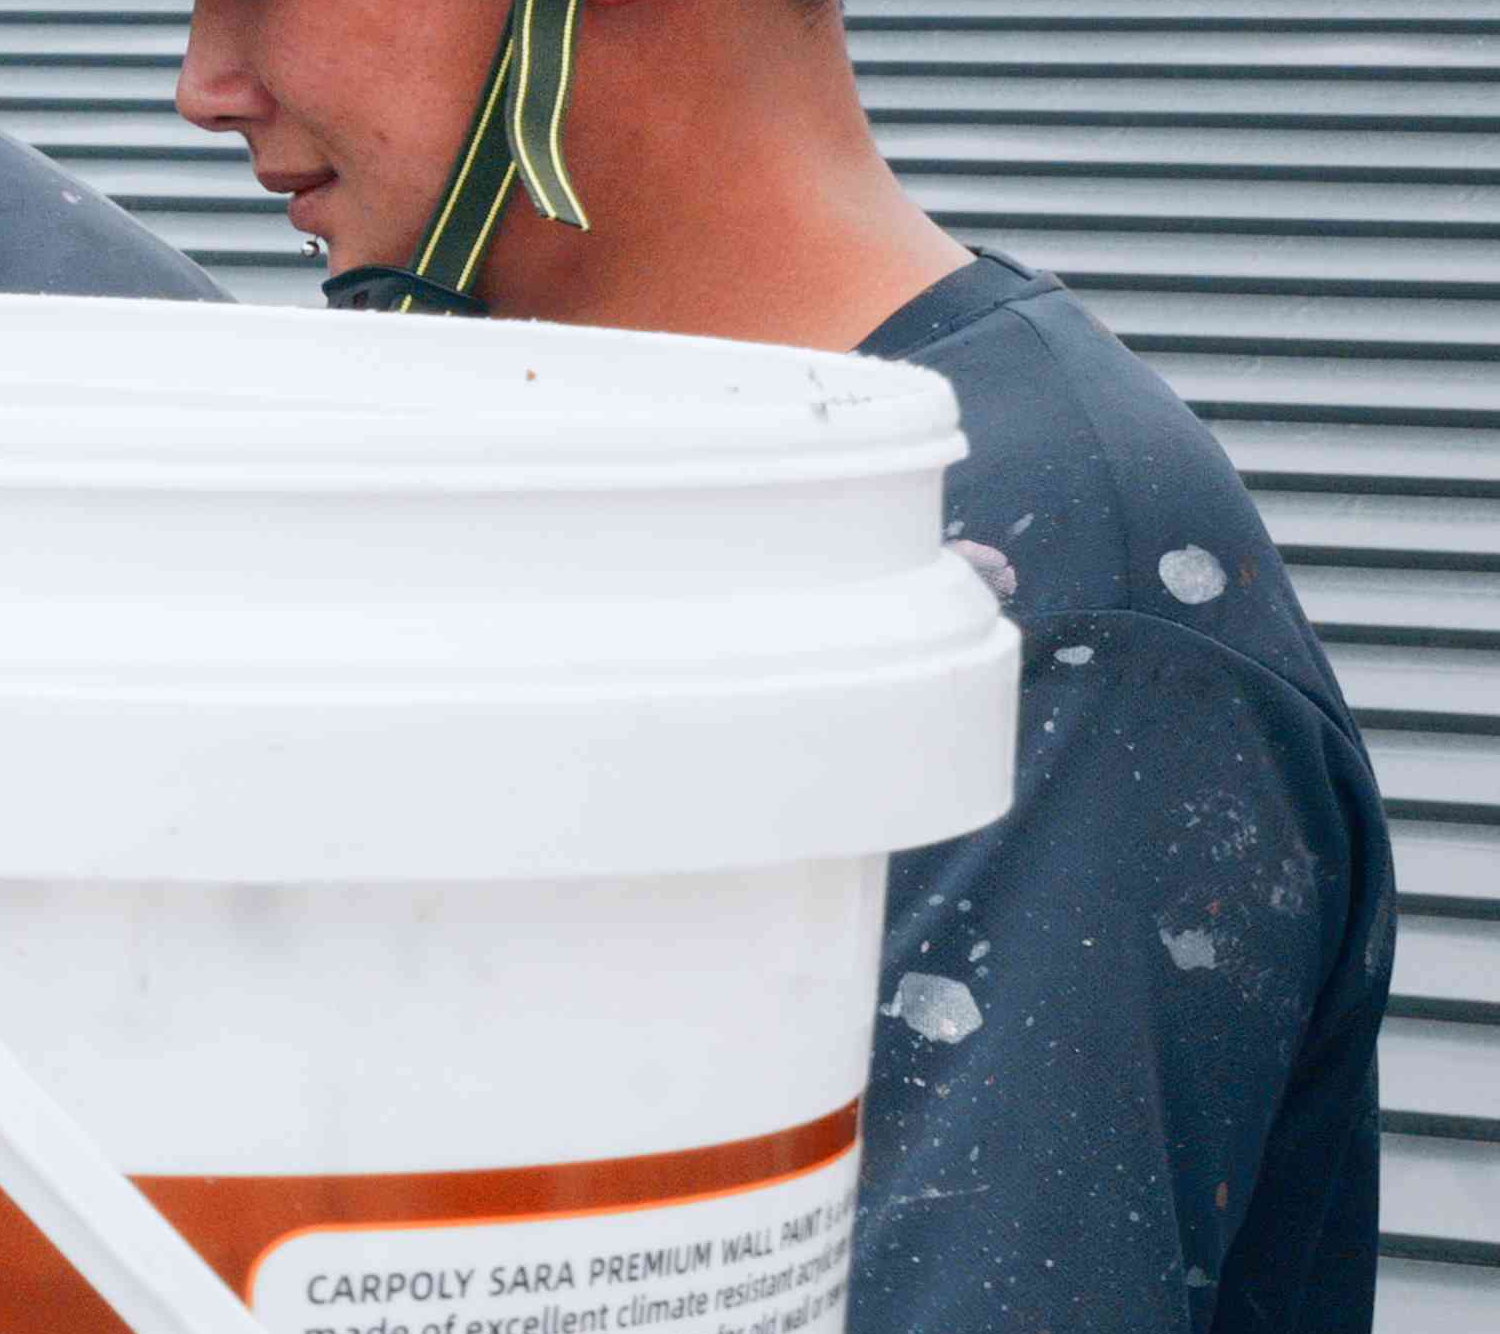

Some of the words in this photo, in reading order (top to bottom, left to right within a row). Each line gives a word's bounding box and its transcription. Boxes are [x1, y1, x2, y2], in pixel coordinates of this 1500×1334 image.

[306, 1268, 476, 1305] CARPOLY
[488, 1261, 575, 1297] SARA
[588, 1239, 713, 1287] PREMIUM
[721, 1227, 773, 1265] WALL
[781, 1207, 822, 1247] PAINT
[616, 1291, 708, 1329] climate
[714, 1266, 794, 1311] resistant
